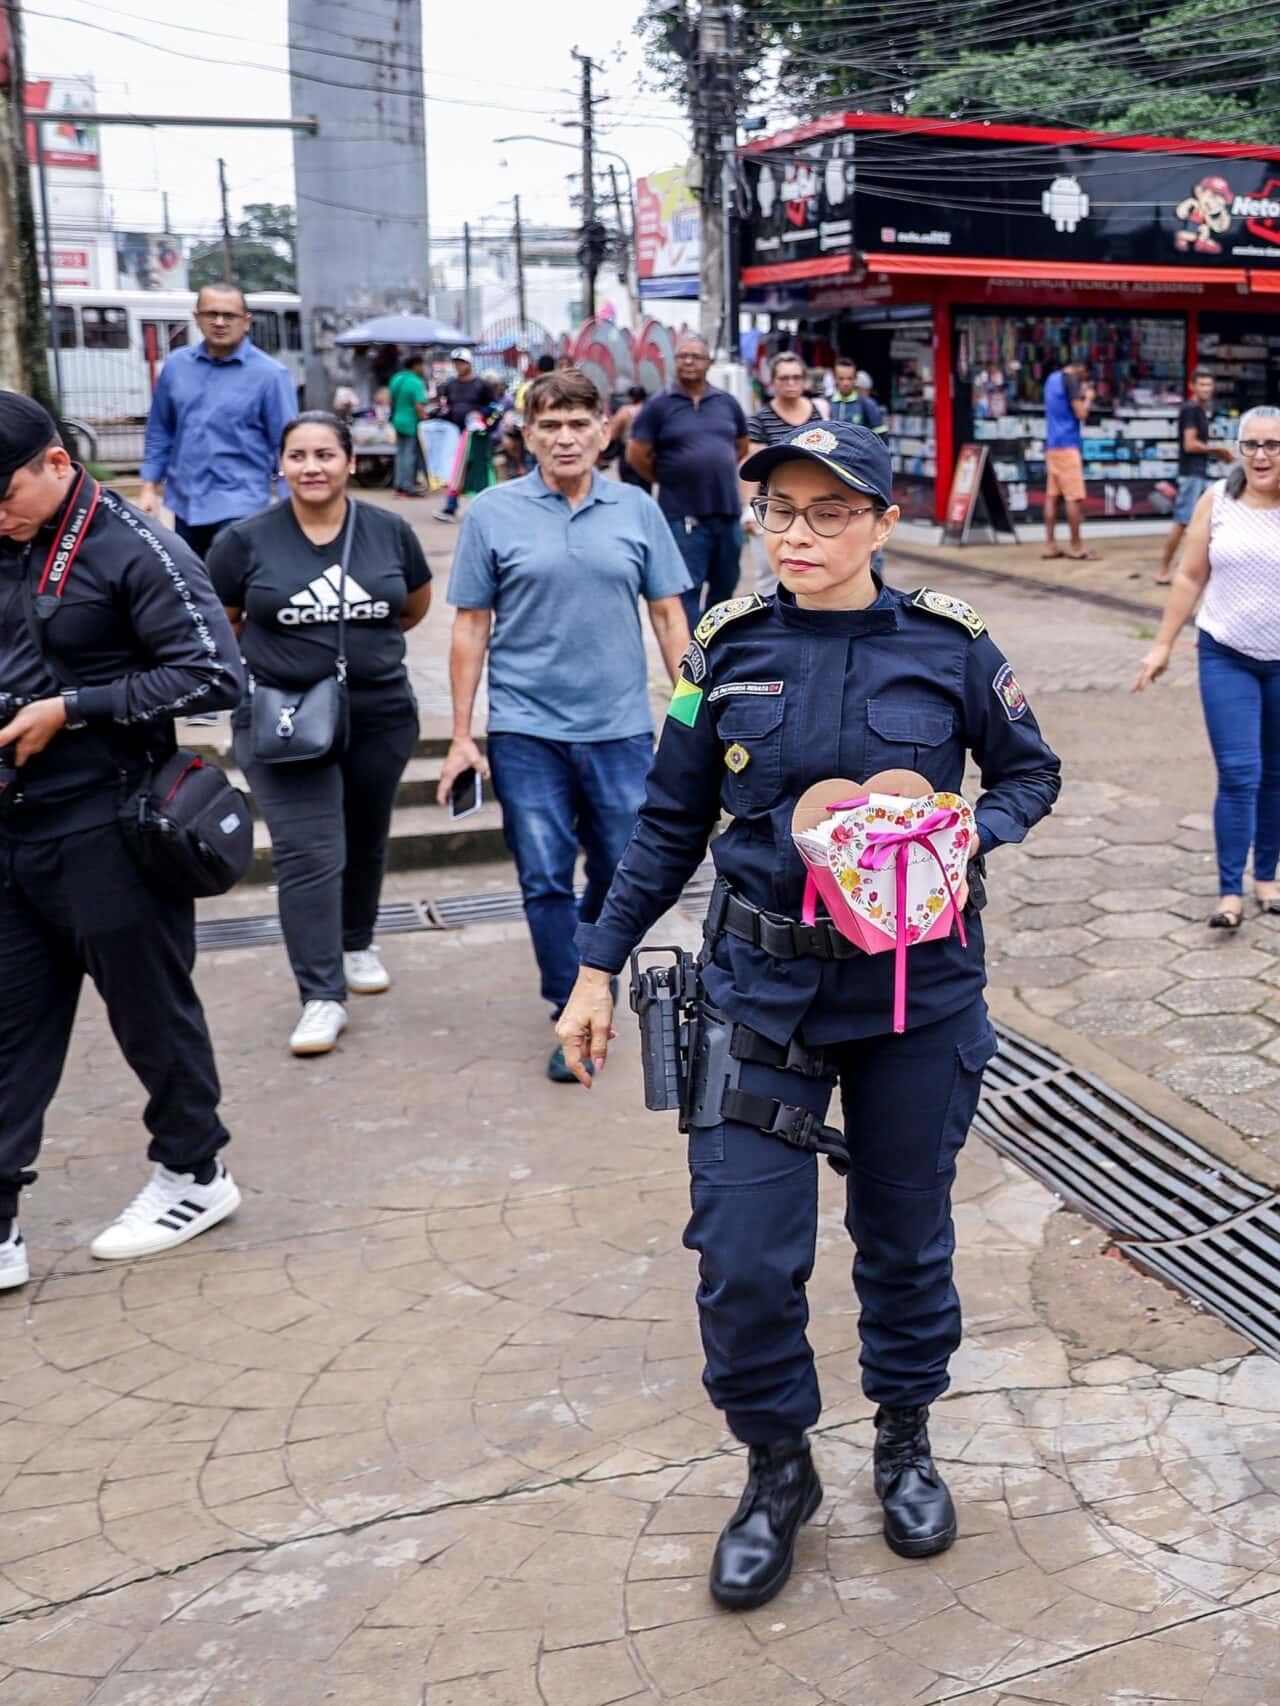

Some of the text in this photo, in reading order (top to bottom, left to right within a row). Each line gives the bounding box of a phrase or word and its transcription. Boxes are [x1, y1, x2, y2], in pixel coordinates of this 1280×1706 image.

[1231, 195, 1280, 218] Neto
[49, 551, 69, 582] EOS
[61, 533, 76, 550] 6D
[277, 600, 390, 625] adidas
